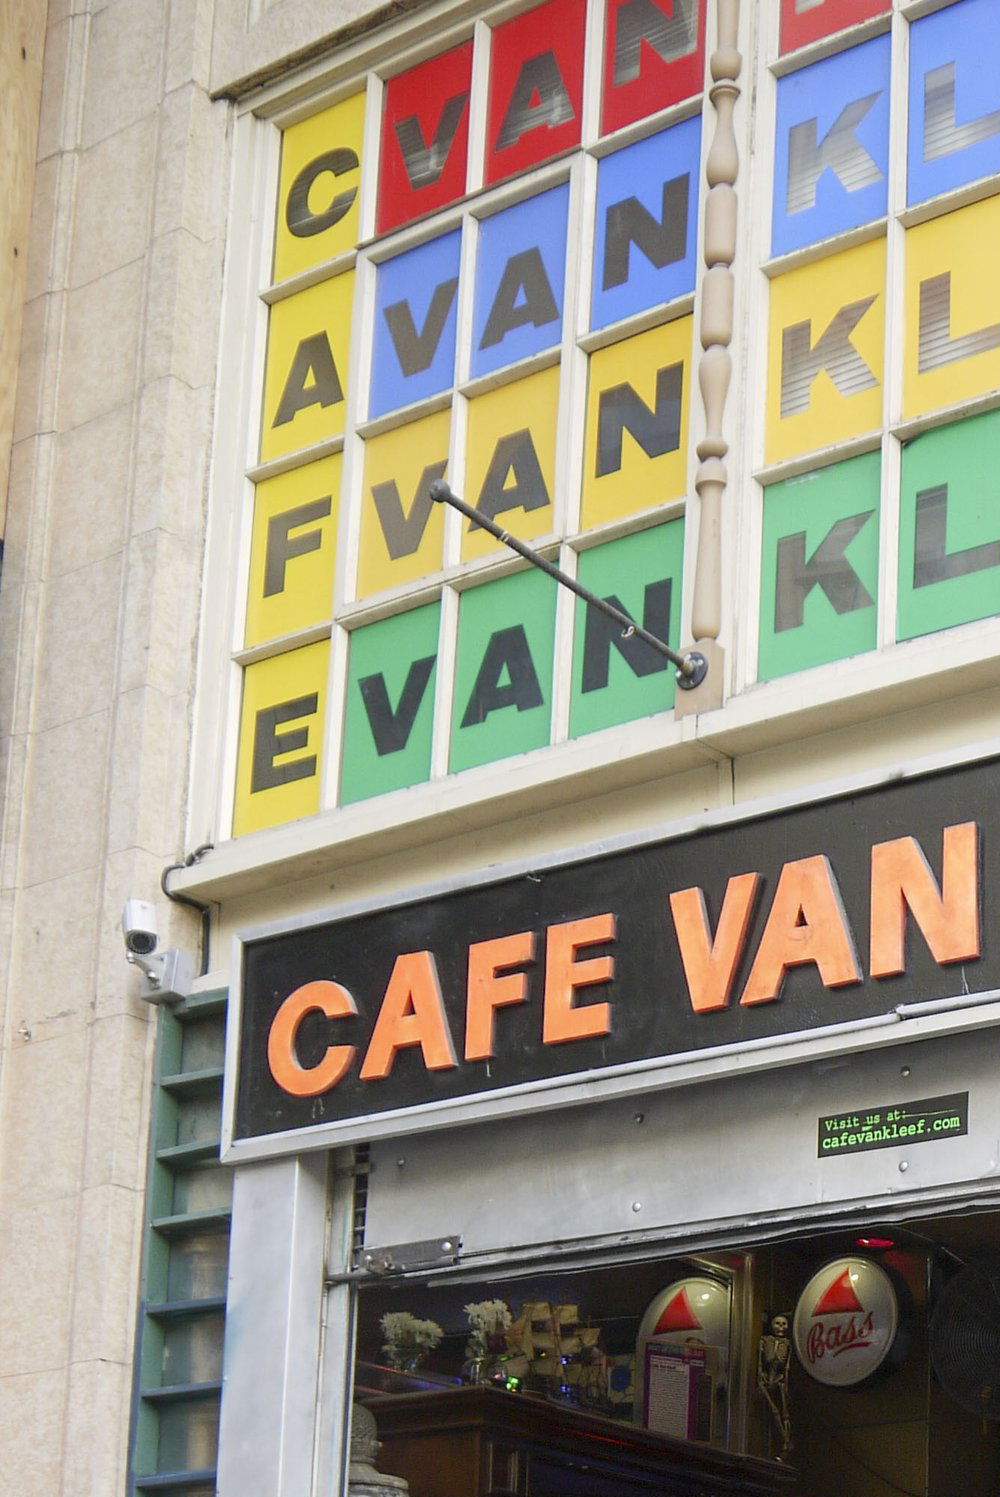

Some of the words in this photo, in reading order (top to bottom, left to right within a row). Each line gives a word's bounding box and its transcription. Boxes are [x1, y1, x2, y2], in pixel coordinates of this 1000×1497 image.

[394, 0, 700, 190] VAN
[383, 172, 691, 378] VAN
[372, 362, 684, 560] VAN
[357, 578, 673, 757] VAN
[267, 912, 616, 1098] CAFE
[669, 821, 982, 1014] VAN
[822, 1116, 961, 1149] cafevankleef.com
[825, 1117, 859, 1131] Visit
[866, 1114, 880, 1124] us
[887, 1109, 906, 1121] at:
[807, 1312, 874, 1364] Bass
